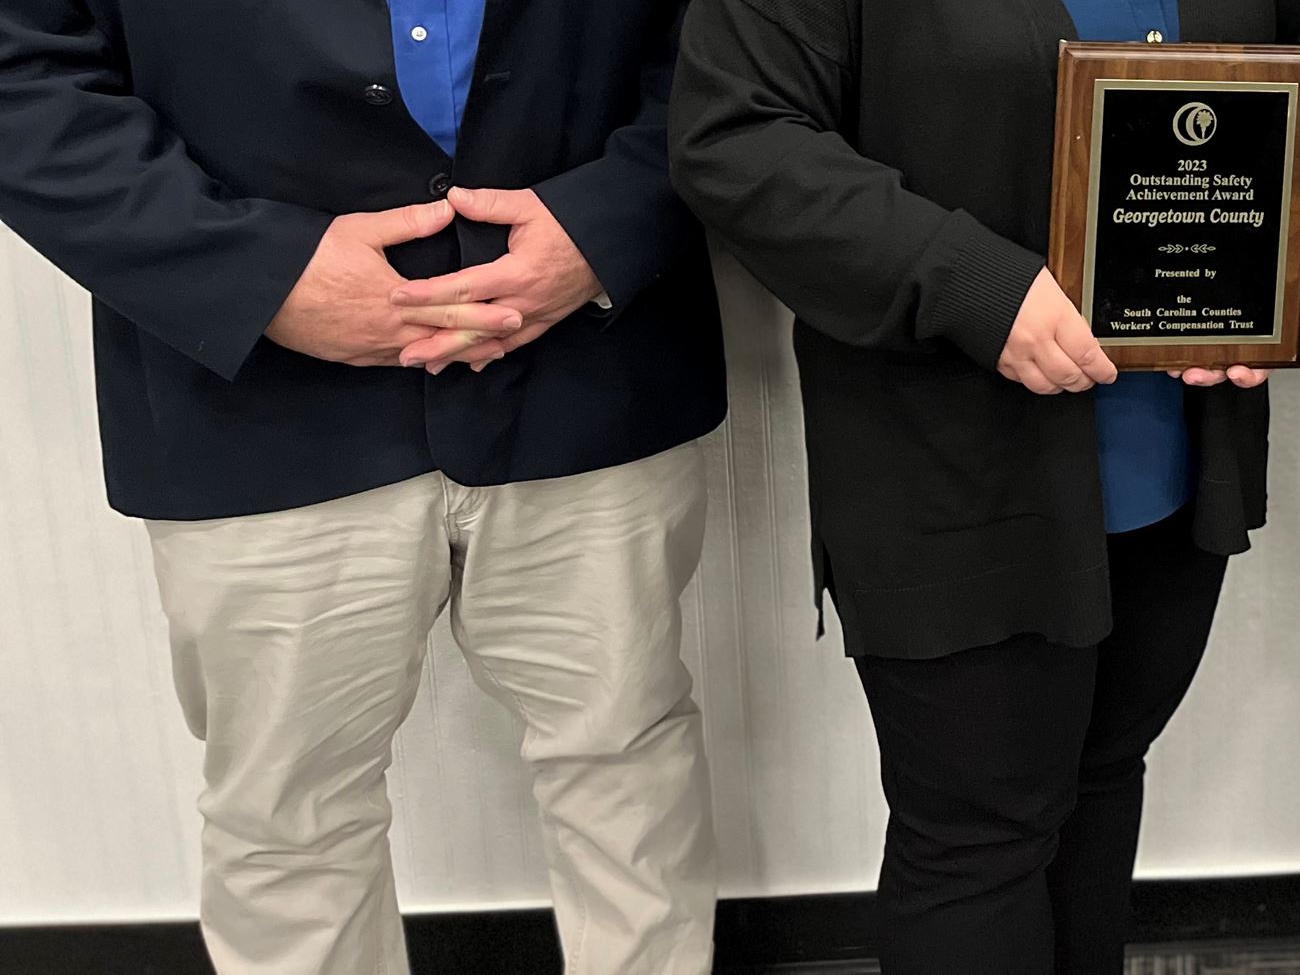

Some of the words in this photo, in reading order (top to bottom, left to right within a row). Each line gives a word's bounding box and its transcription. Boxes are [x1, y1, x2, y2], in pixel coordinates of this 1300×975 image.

[1177, 159, 1207, 171] 2023
[1129, 174, 1210, 189] Outstanding
[1212, 174, 1253, 189] Safety
[1125, 188, 1209, 201] Achievement
[1211, 188, 1254, 201] Award
[1112, 207, 1206, 227] Georgetown
[1209, 208, 1265, 227] County
[1154, 268, 1200, 278] Presented
[1204, 268, 1217, 279] by
[1176, 294, 1192, 304] the
[1123, 308, 1151, 318] South
[1156, 307, 1197, 317] Carolina
[1201, 307, 1242, 317] Counties
[1110, 321, 1154, 331] Workers'
[1158, 320, 1225, 332] Compensation
[1228, 319, 1254, 330] Trust
